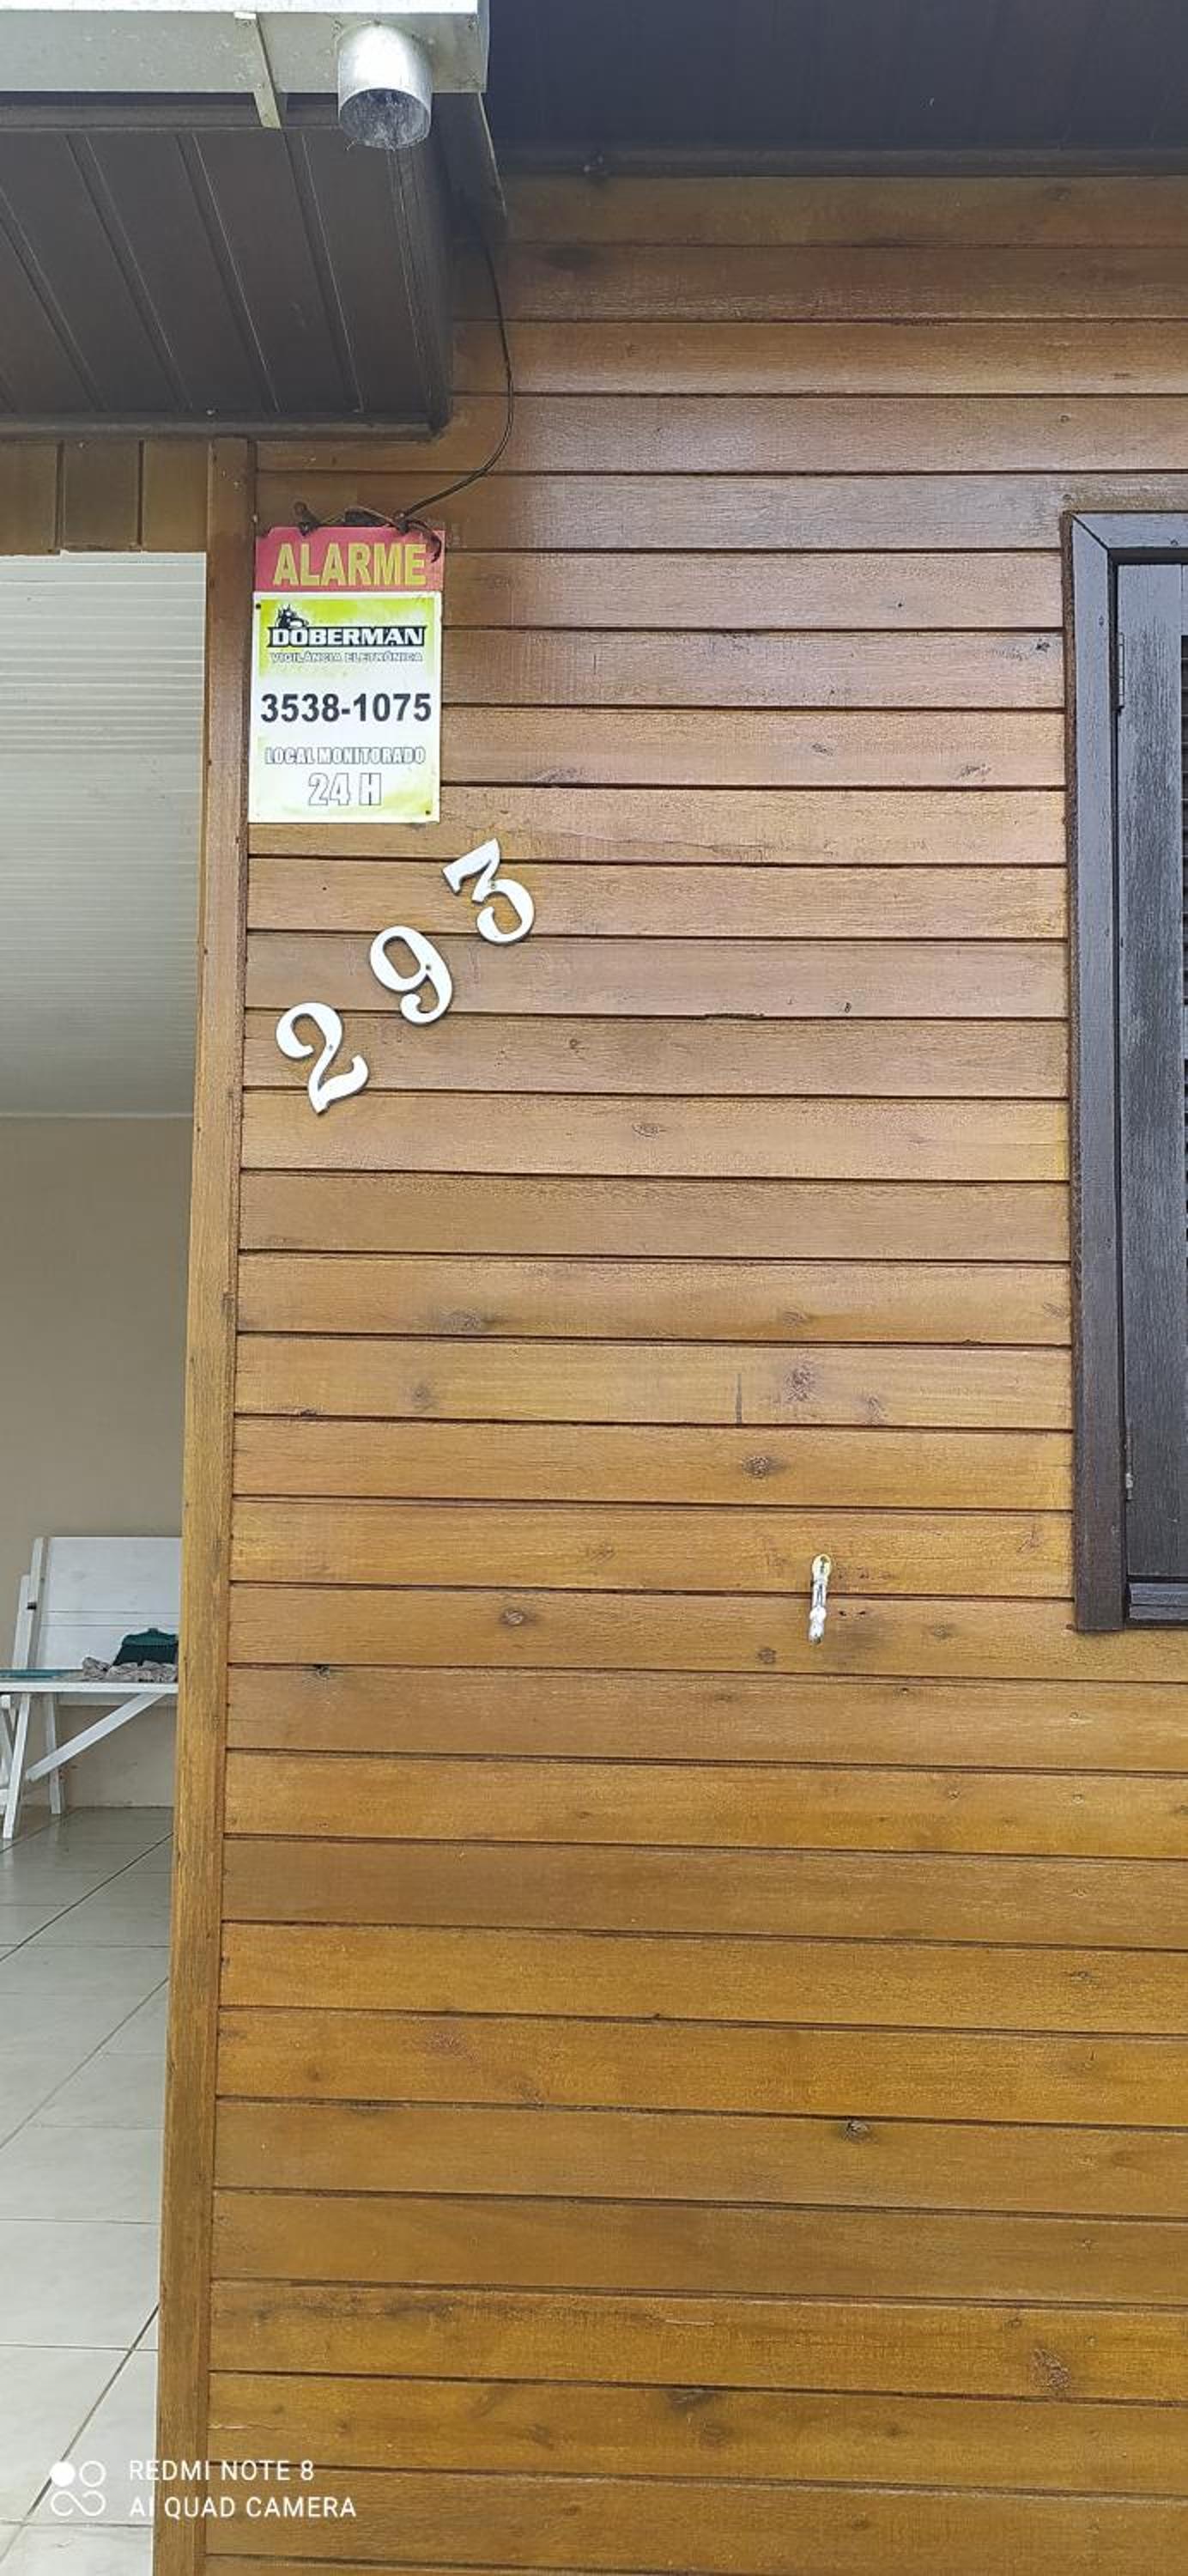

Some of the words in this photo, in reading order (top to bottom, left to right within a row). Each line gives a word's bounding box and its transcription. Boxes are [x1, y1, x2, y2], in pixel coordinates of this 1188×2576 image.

[273, 543, 427, 586] ALARME
[272, 628, 423, 646] DOBERMAN
[260, 693, 432, 723] 3538-1075
[265, 746, 315, 764] LOCAL
[317, 746, 426, 764] MONITORADO
[308, 773, 350, 805] 24
[359, 773, 382, 805] H
[276, 838, 536, 1115] 293
